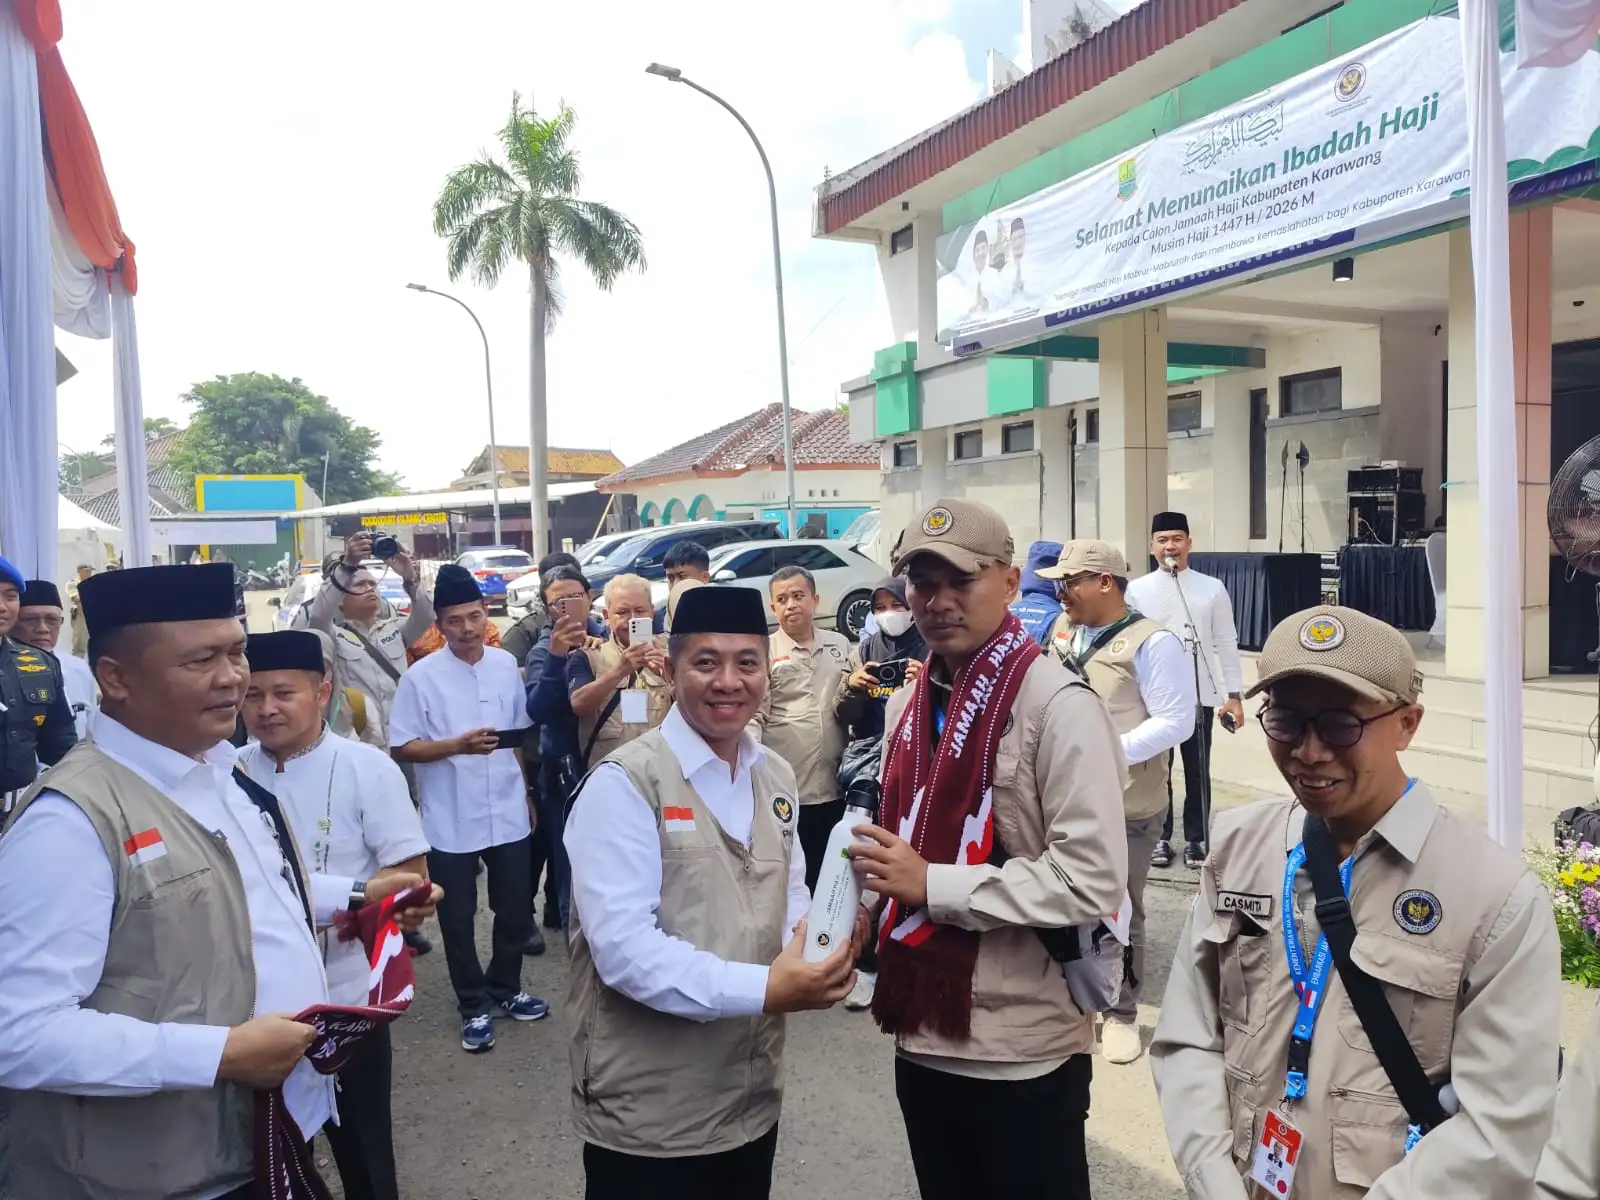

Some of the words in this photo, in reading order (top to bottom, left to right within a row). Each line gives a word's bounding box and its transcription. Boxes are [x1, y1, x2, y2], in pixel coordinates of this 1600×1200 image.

[1075, 207, 1143, 249] Selamat
[1147, 161, 1276, 224] Menunaikan
[1282, 121, 1371, 175] Ibadah
[1379, 91, 1439, 140] Haji
[1105, 232, 1140, 255] Kepada
[1142, 225, 1170, 242] Calon
[1172, 209, 1214, 232] Jamaah
[1216, 198, 1239, 218] Haji
[1241, 176, 1308, 209] Kabupaten
[1311, 150, 1382, 184] Karawang
[1191, 250, 1208, 262] dan
[1208, 235, 1255, 258] membawa
[1257, 214, 1324, 241] kemaslahatan
[1327, 205, 1350, 222] bagi
[1352, 185, 1414, 212] Kabupaten
[1416, 167, 1471, 193] Karawan
[1151, 235, 1185, 256] Musim
[1187, 227, 1209, 245] Haji
[1212, 215, 1242, 237] 1447
[1245, 211, 1255, 226] H
[1265, 196, 1298, 220] 2026
[1301, 191, 1315, 208] M
[1287, 931, 1301, 975] KEMENTERIAN
